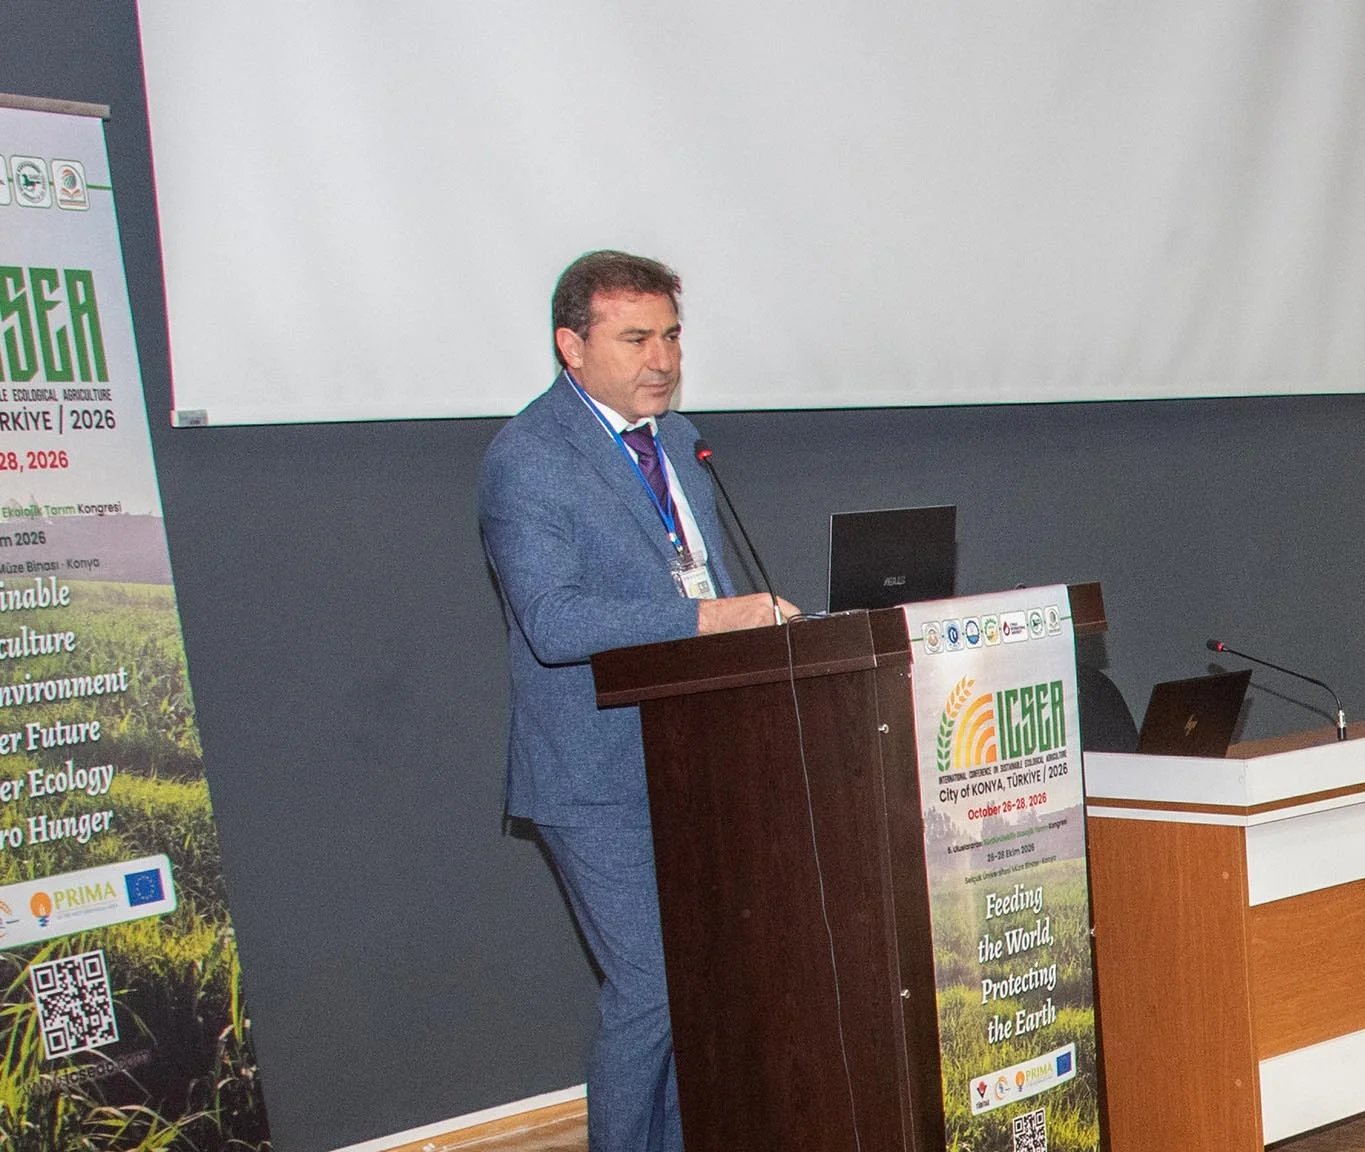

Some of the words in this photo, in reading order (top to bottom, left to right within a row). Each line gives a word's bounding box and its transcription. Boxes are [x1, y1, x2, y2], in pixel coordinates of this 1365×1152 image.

[0, 266, 109, 382] SEA
[12, 388, 58, 402] ECOLOGICAL
[63, 388, 112, 402] AGRICULTURE
[70, 409, 116, 430] 2026
[26, 450, 69, 470] 2026
[77, 500, 122, 516] Kongresi
[14, 531, 46, 546] 2026
[66, 558, 100, 572] Konya
[25, 720, 101, 751] Future
[996, 679, 1067, 761] ICSEA
[27, 760, 114, 798] Ecology
[939, 787, 959, 804] City
[960, 784, 970, 799] of
[972, 778, 1006, 796] KONYA,
[1007, 769, 1041, 789] TÜRKİYE
[1048, 762, 1068, 779] 2026
[967, 804, 1002, 821] October
[1029, 792, 1048, 807] 2026
[27, 810, 114, 845] Hunger
[53, 881, 117, 910] PRIMA
[985, 883, 1043, 920] Feeding
[978, 934, 1003, 964] the
[1004, 916, 1054, 956] World,
[981, 961, 1057, 1005] Protecting
[988, 1015, 1012, 1044] the
[1015, 997, 1056, 1036] Earth
[1025, 1063, 1053, 1081] PRIMA
